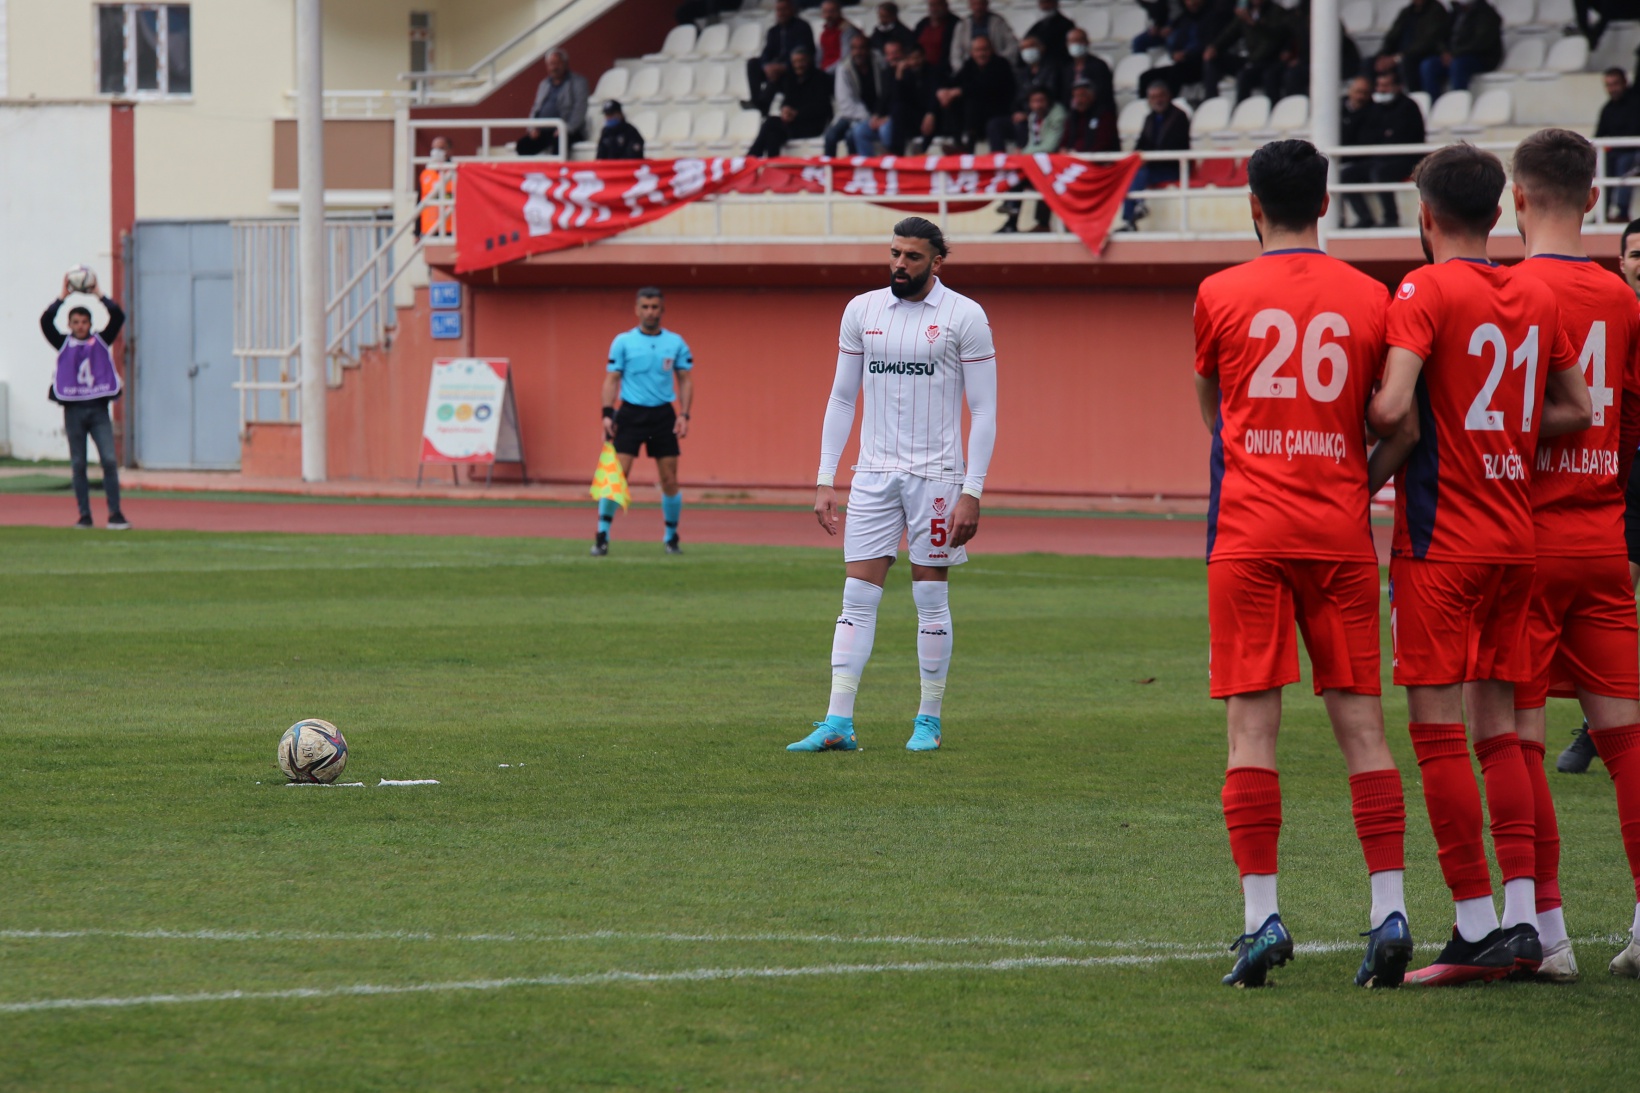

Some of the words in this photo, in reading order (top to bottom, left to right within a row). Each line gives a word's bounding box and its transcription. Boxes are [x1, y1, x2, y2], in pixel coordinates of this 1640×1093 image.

[868, 361, 935, 376] GÜMÜŞSU
[1247, 308, 1350, 402] 26
[77, 358, 95, 388] 4
[1465, 323, 1539, 432] 21
[1245, 429, 1282, 454] ONUR
[1285, 429, 1346, 464] ÇAKMAKÇI
[1536, 446, 1554, 472] M.
[930, 518, 947, 547] 5
